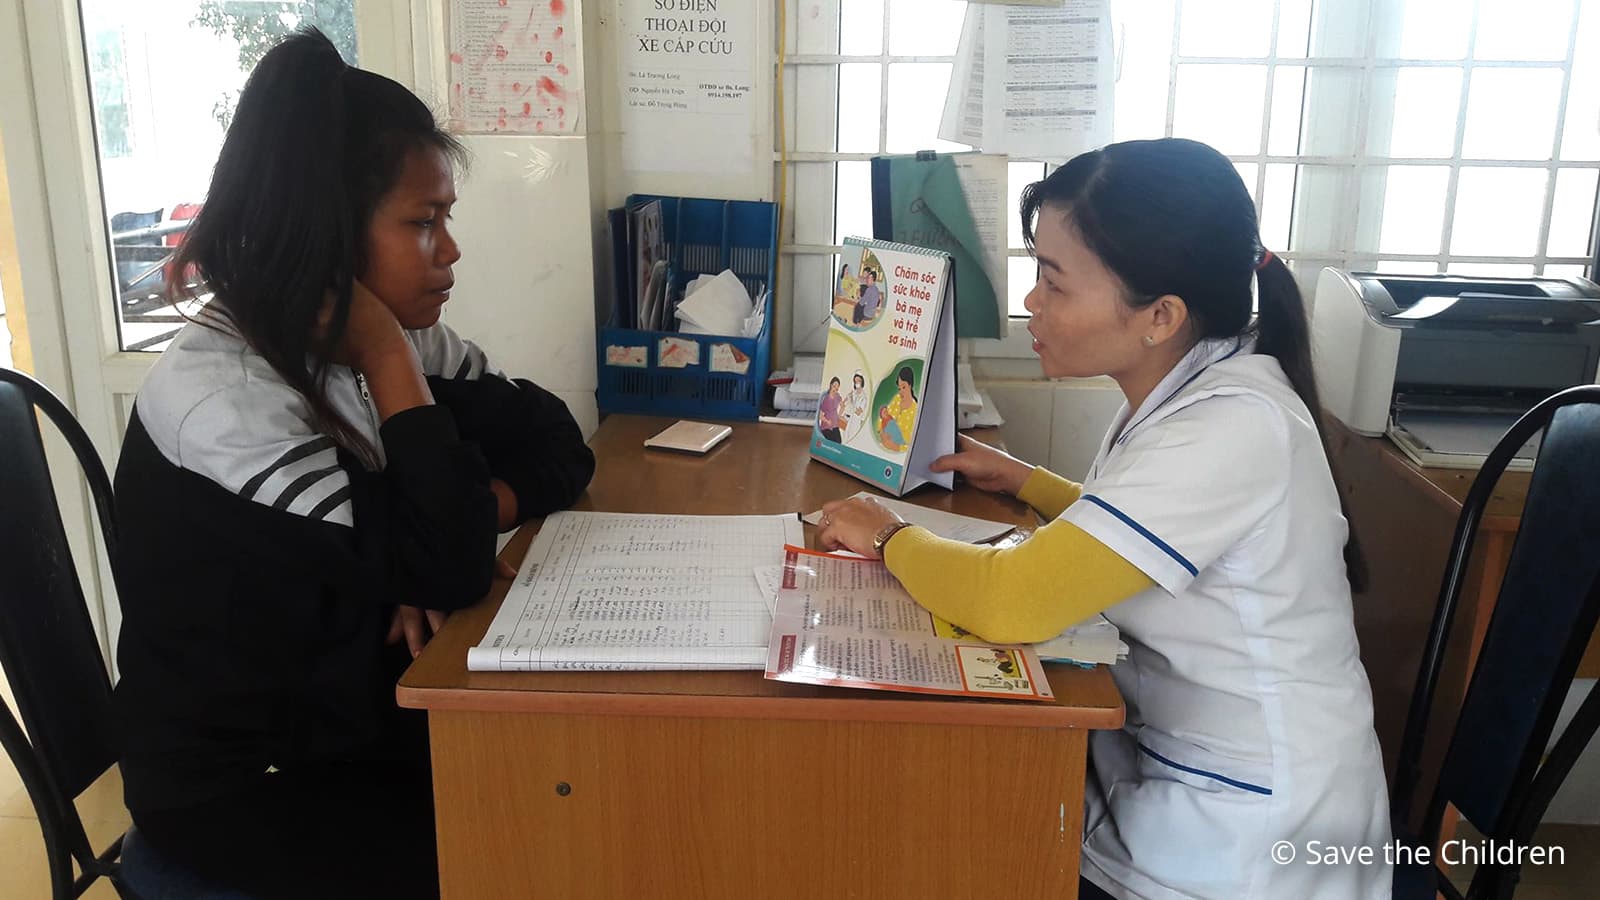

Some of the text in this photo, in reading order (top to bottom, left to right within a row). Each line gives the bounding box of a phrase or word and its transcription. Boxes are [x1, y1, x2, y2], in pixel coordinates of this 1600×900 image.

[645, 18, 694, 35] THOẠI
[638, 38, 659, 53] XE
[698, 37, 733, 55] CỨU
[921, 271, 936, 285] sóc
[893, 282, 908, 296] sức
[895, 299, 923, 320] bà mẹ
[893, 318, 919, 333] và trẻ
[888, 334, 918, 351] sơ sinh
